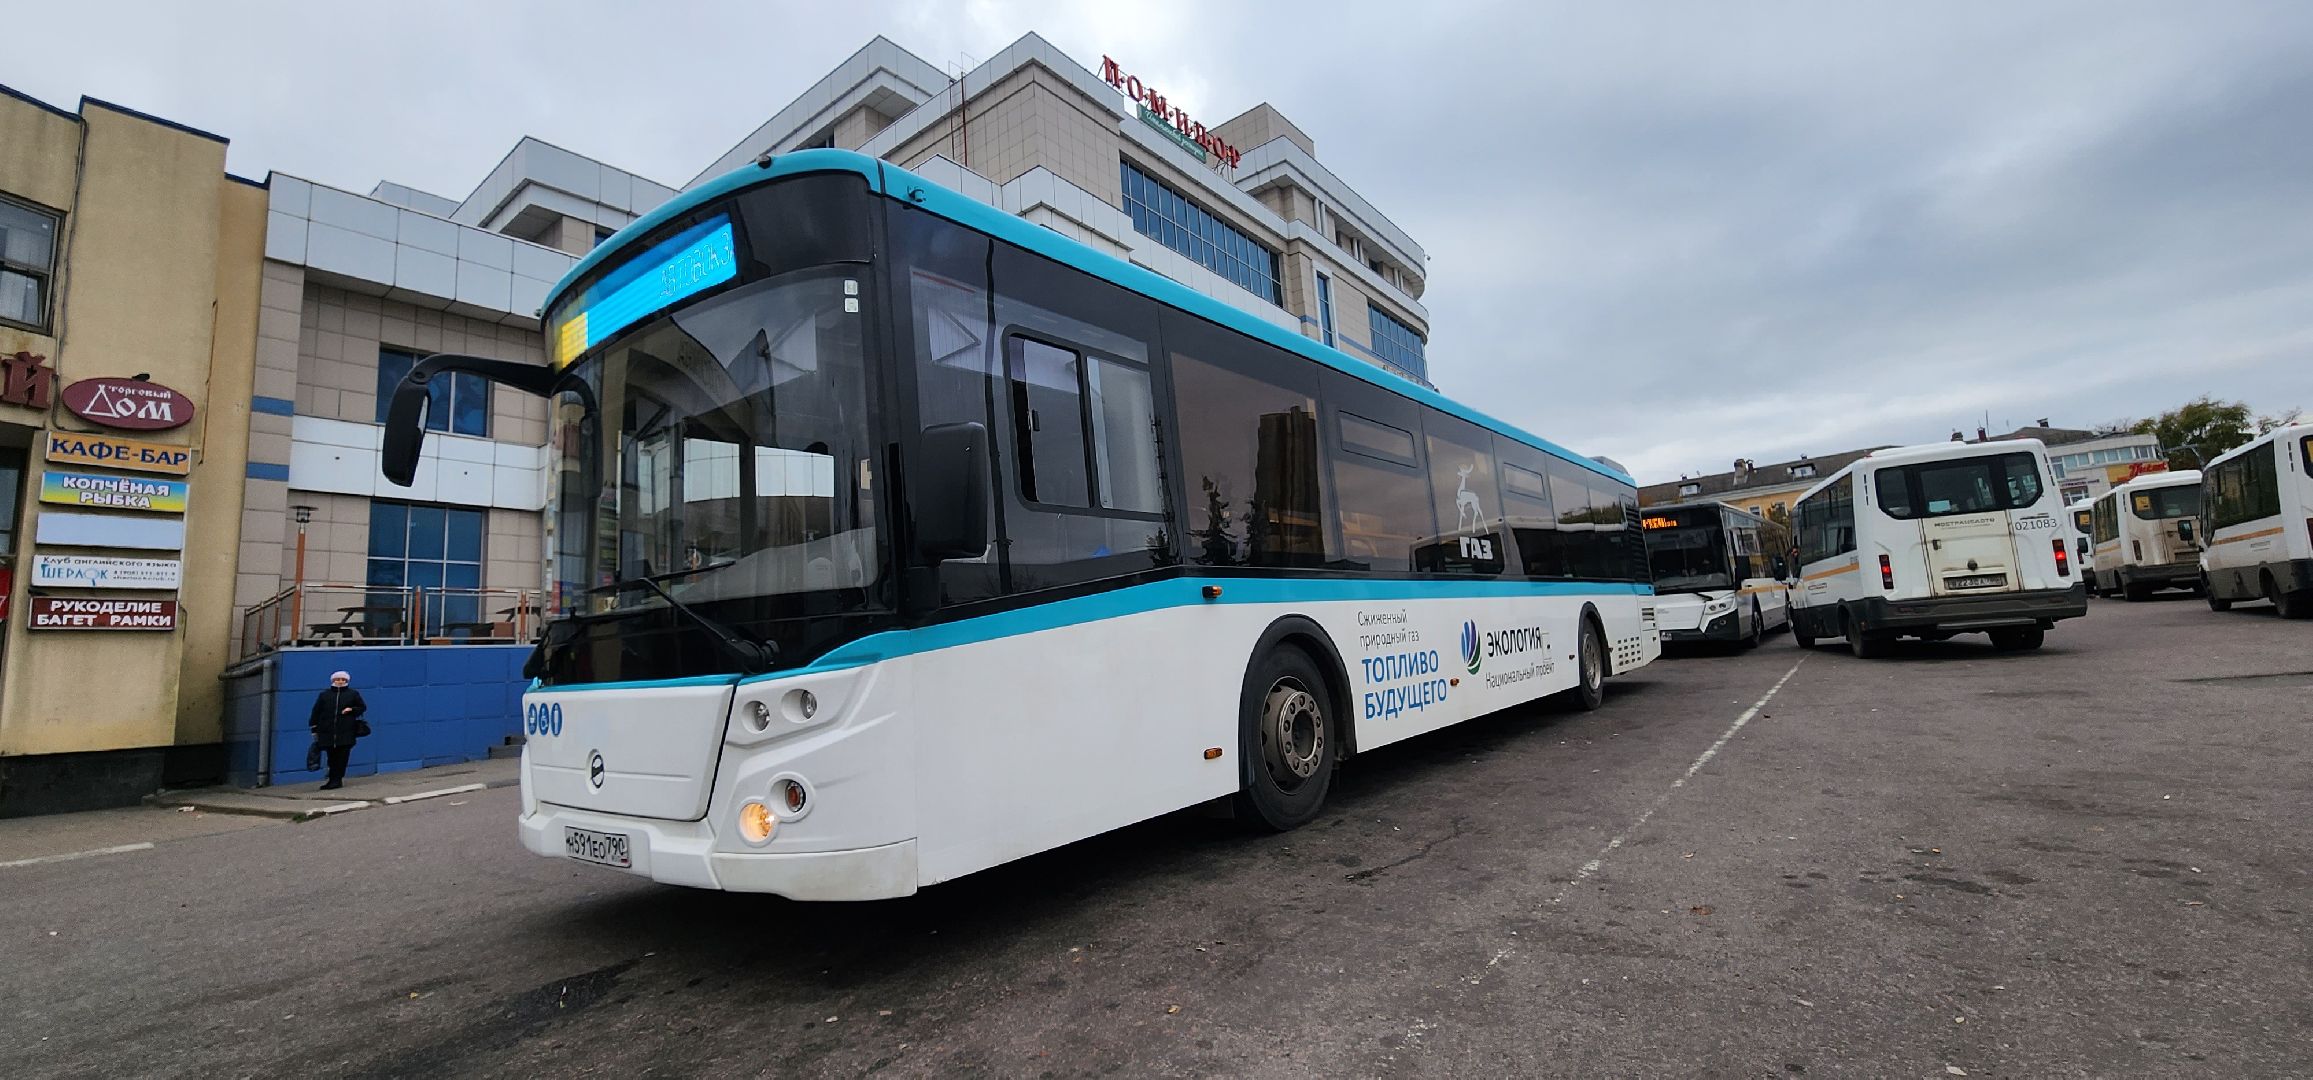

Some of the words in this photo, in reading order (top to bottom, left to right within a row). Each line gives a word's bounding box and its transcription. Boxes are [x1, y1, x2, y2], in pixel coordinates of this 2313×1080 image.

[51, 438, 188, 466] КАФЕ-БАР
[62, 476, 170, 497] КОПЧЁНАЯ
[80, 491, 152, 508] РЫБКА
[2015, 518, 2057, 531] 021083
[1459, 536, 1493, 560] ГАЗ
[42, 556, 71, 565] Клуб
[74, 559, 143, 567] английского
[41, 564, 108, 586] ШЕРЛОК
[50, 601, 162, 614] РУКОДЕЛИЕ
[1357, 609, 1408, 627] Сжиженный
[37, 614, 97, 626] БАГЕТ
[110, 615, 171, 626] РАМКИ
[1359, 628, 1407, 650] природный
[1408, 630, 1419, 643] газ
[1487, 626, 1542, 658] ЭКОЛОГИЯ
[1361, 650, 1439, 685] ТОПЛИВО
[1485, 662, 1536, 690] Национальный
[1536, 662, 1555, 681] проект
[1364, 679, 1447, 721] БУДУЩЕГО
